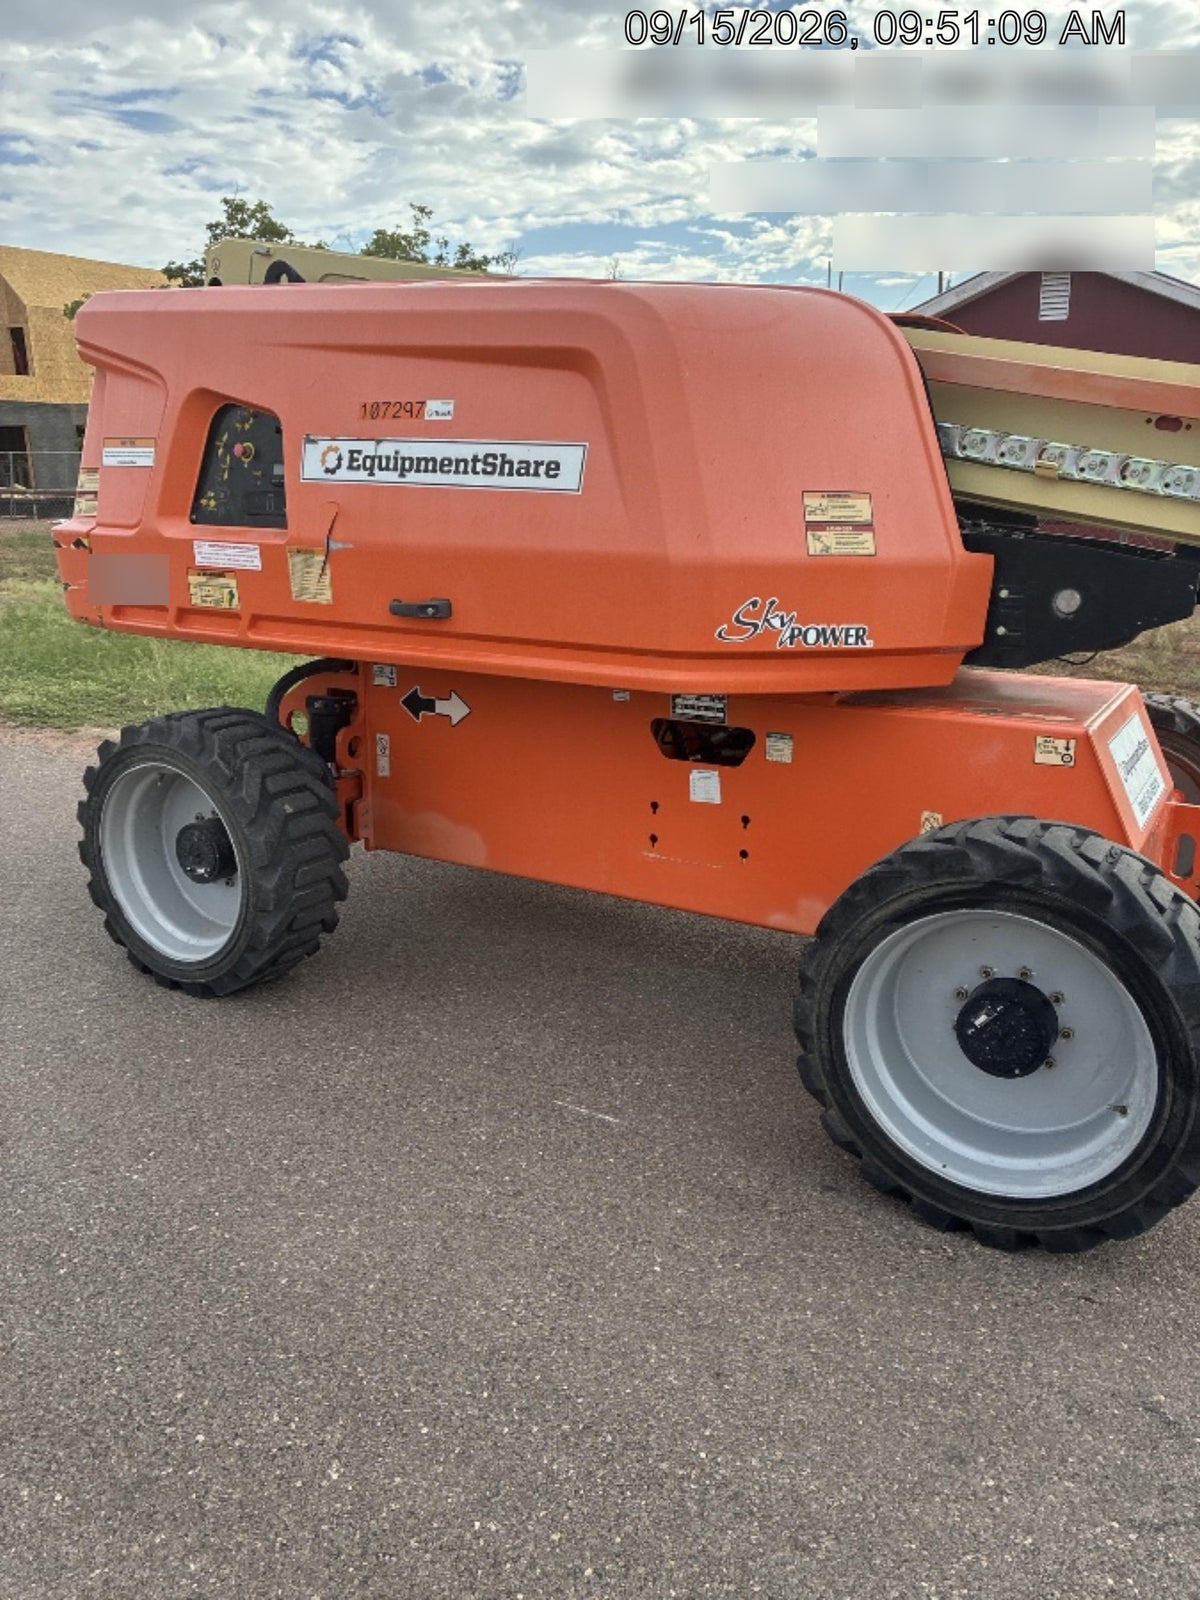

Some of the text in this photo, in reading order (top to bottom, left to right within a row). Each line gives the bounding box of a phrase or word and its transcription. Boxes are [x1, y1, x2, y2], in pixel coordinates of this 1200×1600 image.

[361, 401, 426, 419] 107297
[346, 448, 562, 479] EquipmentShare
[717, 596, 870, 648] Sky POWER
